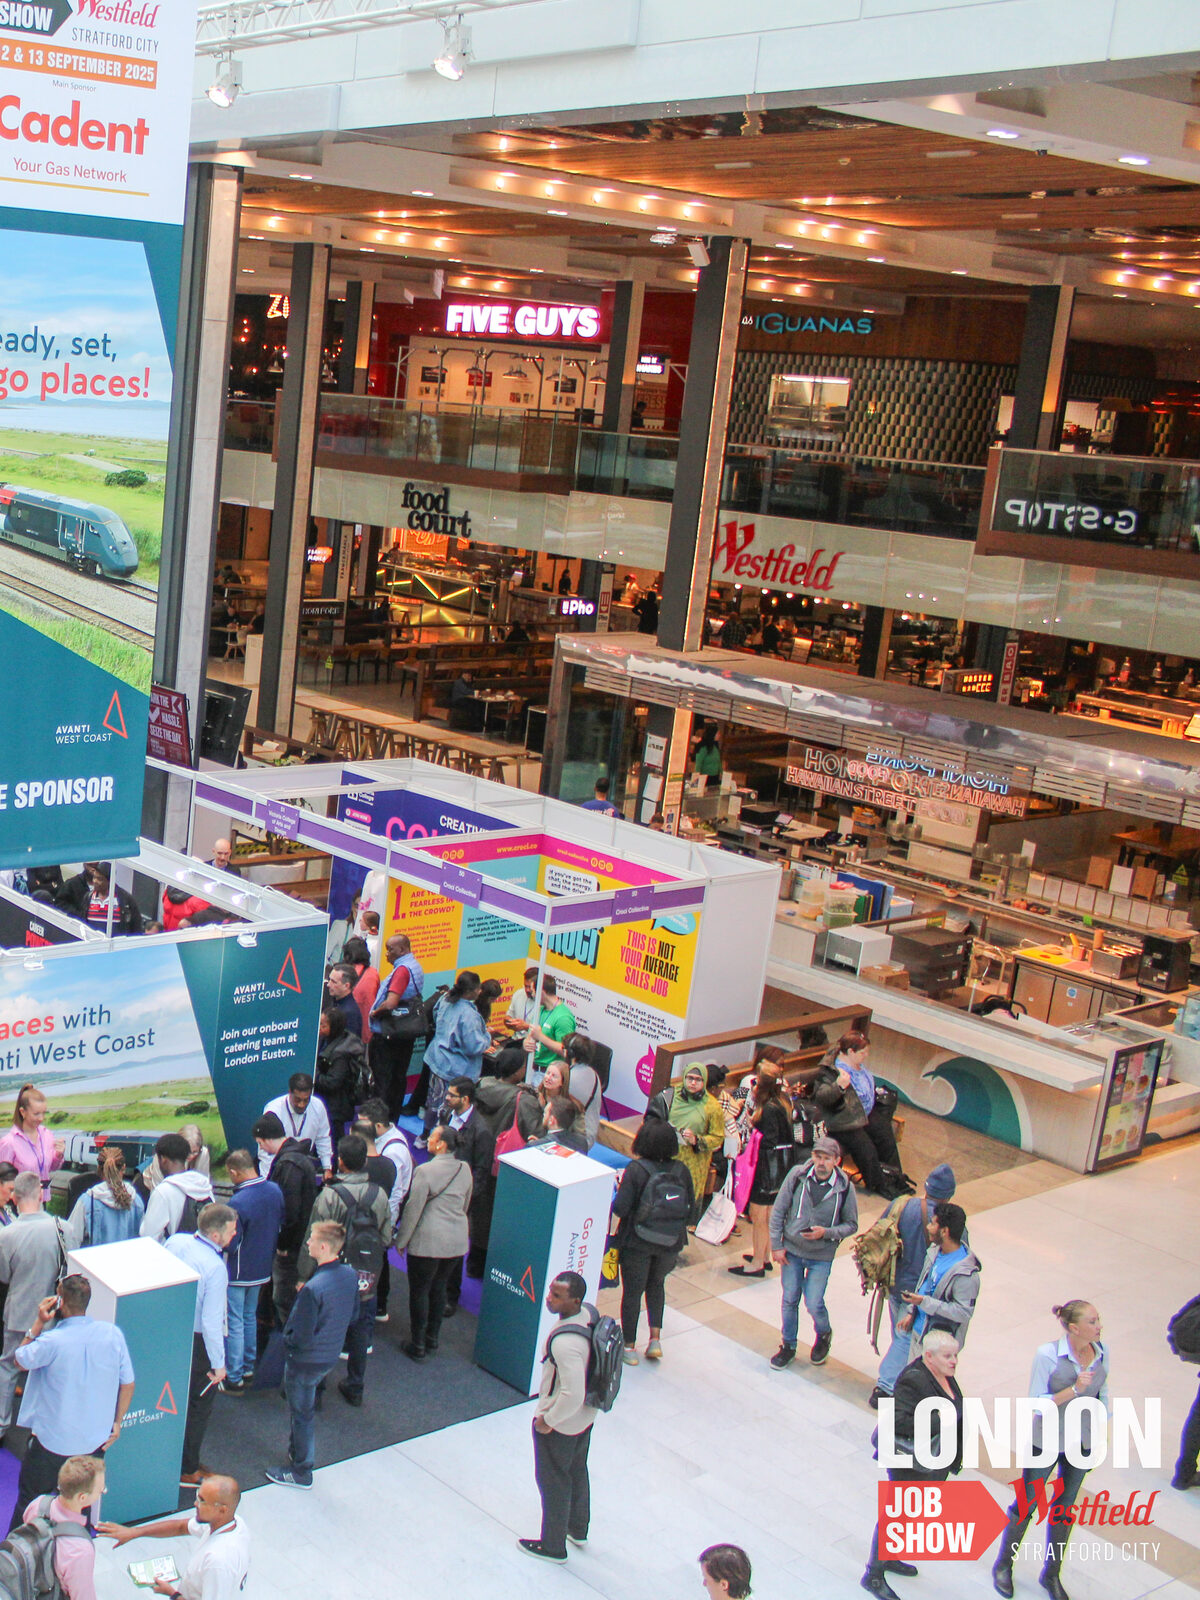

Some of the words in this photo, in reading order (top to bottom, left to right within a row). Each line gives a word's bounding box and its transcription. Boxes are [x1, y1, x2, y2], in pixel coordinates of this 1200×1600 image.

[76, 0, 161, 28] Westfield
[72, 27, 133, 50] STRATFORD
[136, 35, 159, 54] CITY
[14, 48, 23, 63] &
[28, 49, 43, 66] 13
[47, 51, 121, 77] SEPTEMBER
[125, 63, 155, 82] 2025
[52, 80, 70, 88] Main
[71, 81, 97, 93] Sponsor
[13, 157, 41, 173] Your
[45, 161, 70, 177] Gas
[74, 165, 127, 183] Network
[446, 305, 510, 333] FIVE
[514, 306, 599, 338] GUYS
[71, 333, 117, 362] set,
[40, 362, 150, 401] places!
[401, 481, 450, 514] food
[407, 510, 472, 538] court
[714, 521, 846, 591] Westfield
[569, 599, 594, 615] Pho
[55, 724, 90, 734] AVANTI
[55, 734, 81, 745] WEST
[84, 732, 113, 743] COAST
[14, 776, 114, 809] SPONSOR
[787, 765, 855, 797] HAWAIIAN
[854, 781, 917, 813] STREET
[554, 870, 571, 880] you've
[572, 882, 592, 891] energy,
[443, 881, 455, 891] Croci
[455, 885, 477, 899] Collective
[393, 886, 405, 920] 1.
[410, 898, 444, 907] FEARLESS
[424, 906, 455, 916] CROWD?
[628, 905, 650, 914] Collective
[627, 929, 646, 951] THIS
[648, 936, 657, 955] IS
[658, 940, 676, 961] NOT
[620, 946, 642, 968] YOUR
[643, 955, 679, 983] AVERAGE
[234, 982, 265, 995] AVANTI
[567, 981, 592, 996] Collective,
[625, 967, 650, 990] SALES
[651, 980, 668, 997] JOB
[233, 993, 256, 1004] WEST
[258, 989, 286, 1000] COAST
[565, 987, 592, 1002] differently.
[566, 1000, 577, 1008] YOU.
[63, 1004, 111, 1029] with
[607, 1004, 638, 1020] people-first
[640, 1014, 650, 1022] and
[651, 1018, 667, 1029] made
[617, 1001, 628, 1009] This
[635, 1008, 665, 1024] fast-paced,
[220, 1029, 240, 1040] Join
[242, 1027, 258, 1036] our
[259, 1018, 299, 1033] onboard
[605, 1009, 620, 1018] those
[622, 1015, 632, 1023] who
[634, 1019, 646, 1028] love
[647, 1024, 657, 1032] the
[658, 1028, 676, 1040] hustle
[619, 1021, 629, 1029] and
[631, 1024, 640, 1032] the
[641, 1029, 660, 1041] payoff.
[30, 1040, 86, 1065] West
[94, 1028, 156, 1056] Coast
[224, 1039, 260, 1054] catering
[262, 1036, 286, 1047] team
[288, 1033, 298, 1042] at
[224, 1053, 259, 1068] London
[261, 1049, 296, 1061] Euston.
[582, 1217, 593, 1240] Go
[490, 1274, 506, 1288] WEST
[506, 1283, 525, 1297] COAST
[491, 1267, 512, 1284] AVANTI
[139, 1411, 164, 1424] COAST
